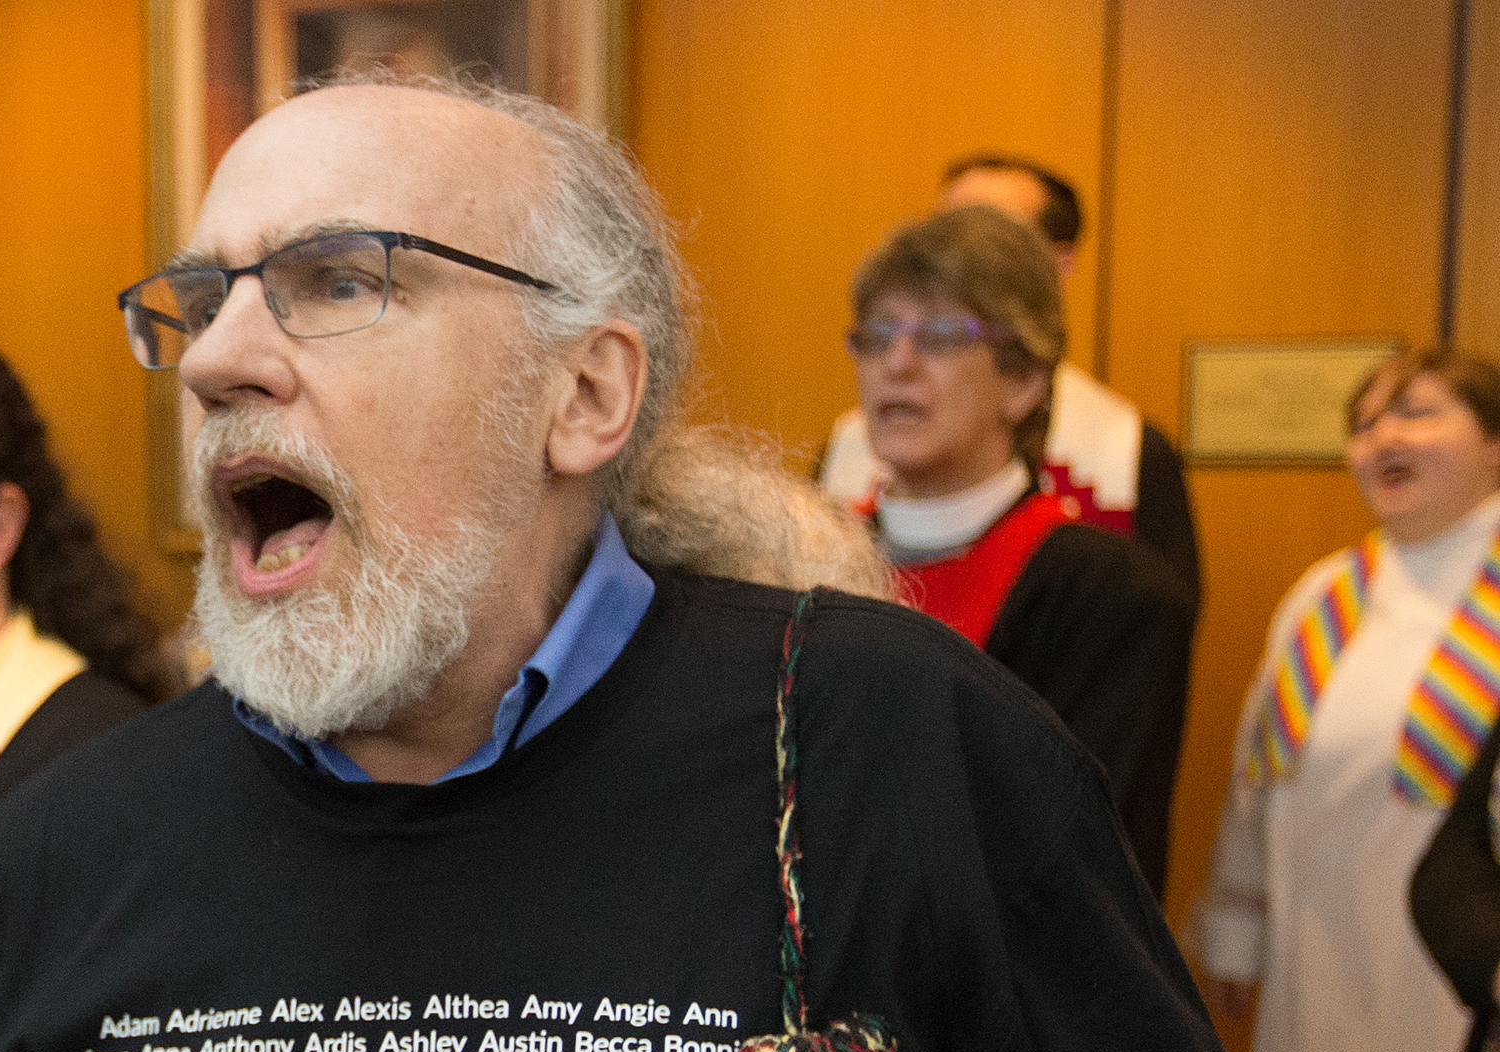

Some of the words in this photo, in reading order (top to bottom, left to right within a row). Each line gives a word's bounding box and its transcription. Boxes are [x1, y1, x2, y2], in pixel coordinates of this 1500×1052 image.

[100, 1015, 160, 1039] Adam
[166, 1007, 262, 1033] Adrienne
[270, 998, 323, 1022] Alex
[335, 996, 411, 1021] Alexis
[423, 994, 509, 1019] Althea
[521, 994, 582, 1024] Amy
[594, 997, 670, 1026] Angie
[683, 1002, 737, 1029] Ann
